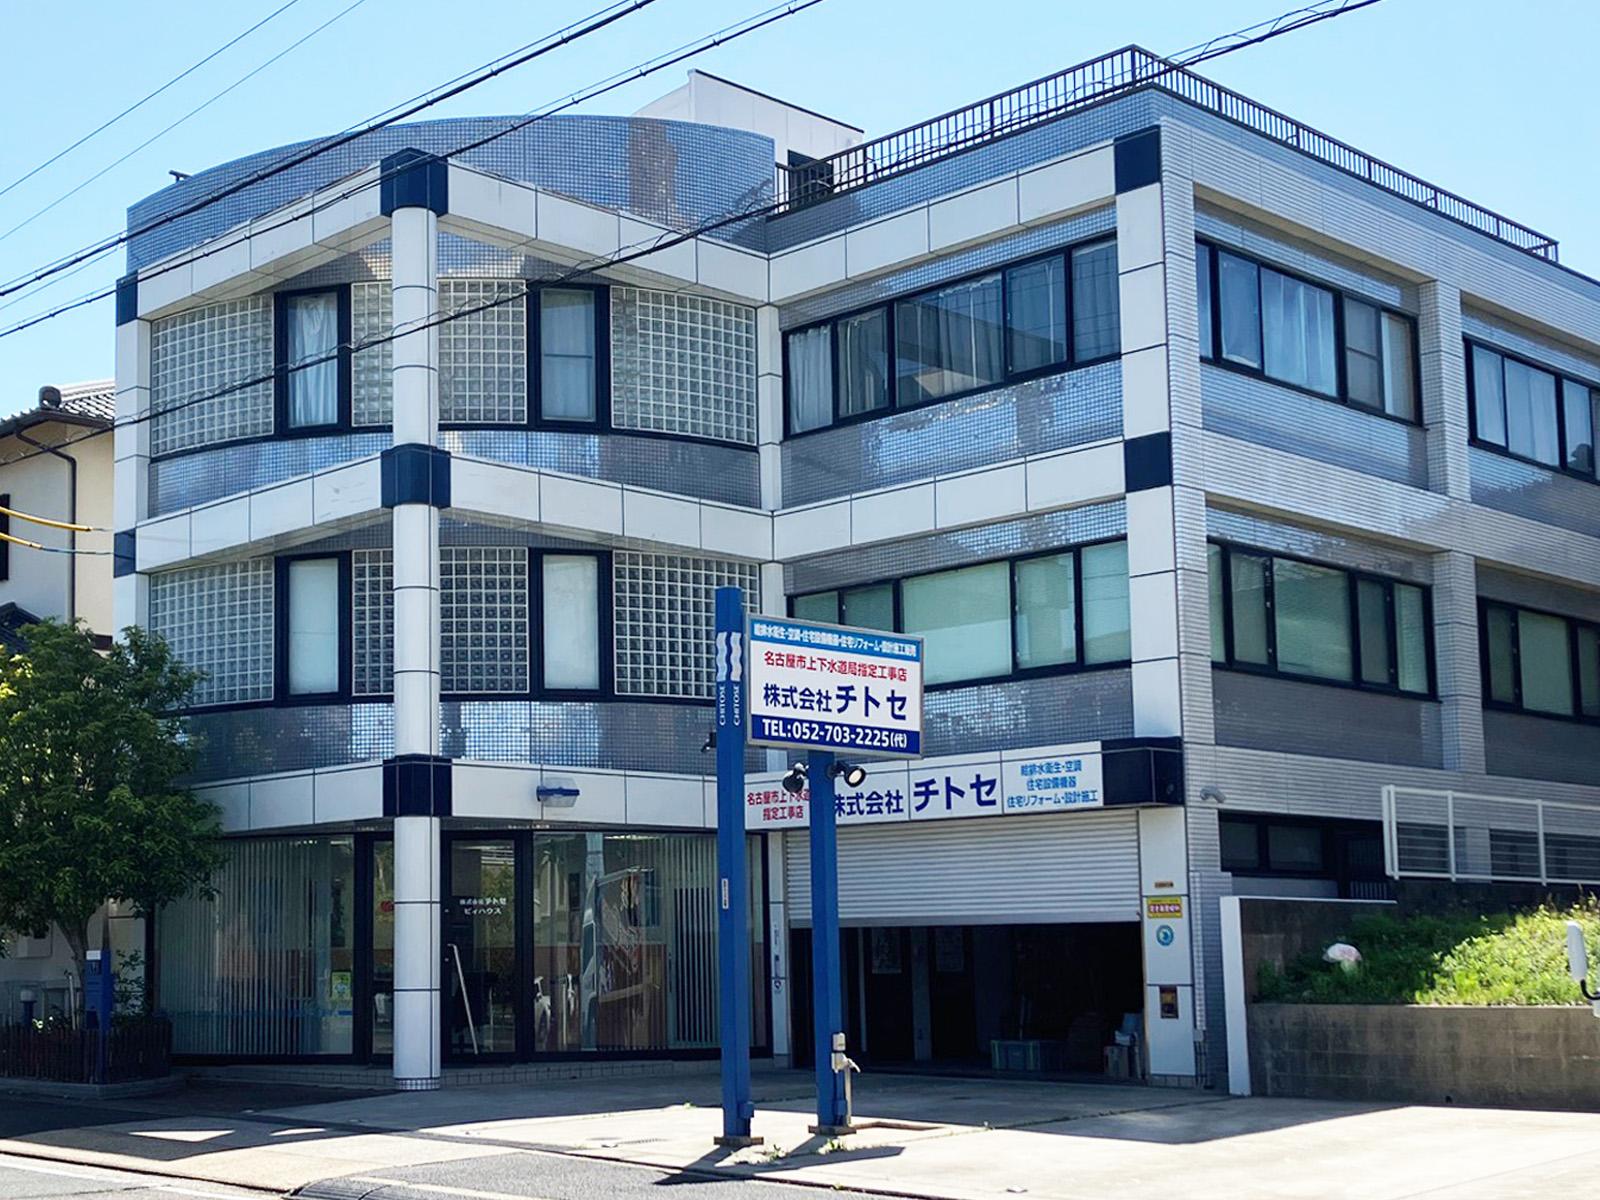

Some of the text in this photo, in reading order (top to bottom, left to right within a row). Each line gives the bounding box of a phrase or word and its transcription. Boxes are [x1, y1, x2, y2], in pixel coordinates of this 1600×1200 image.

[764, 650, 907, 682] 名古屋市上下水道局指定工事店
[763, 683, 907, 721] 株式会社チトセ
[763, 805, 803, 821] 指定工事店
